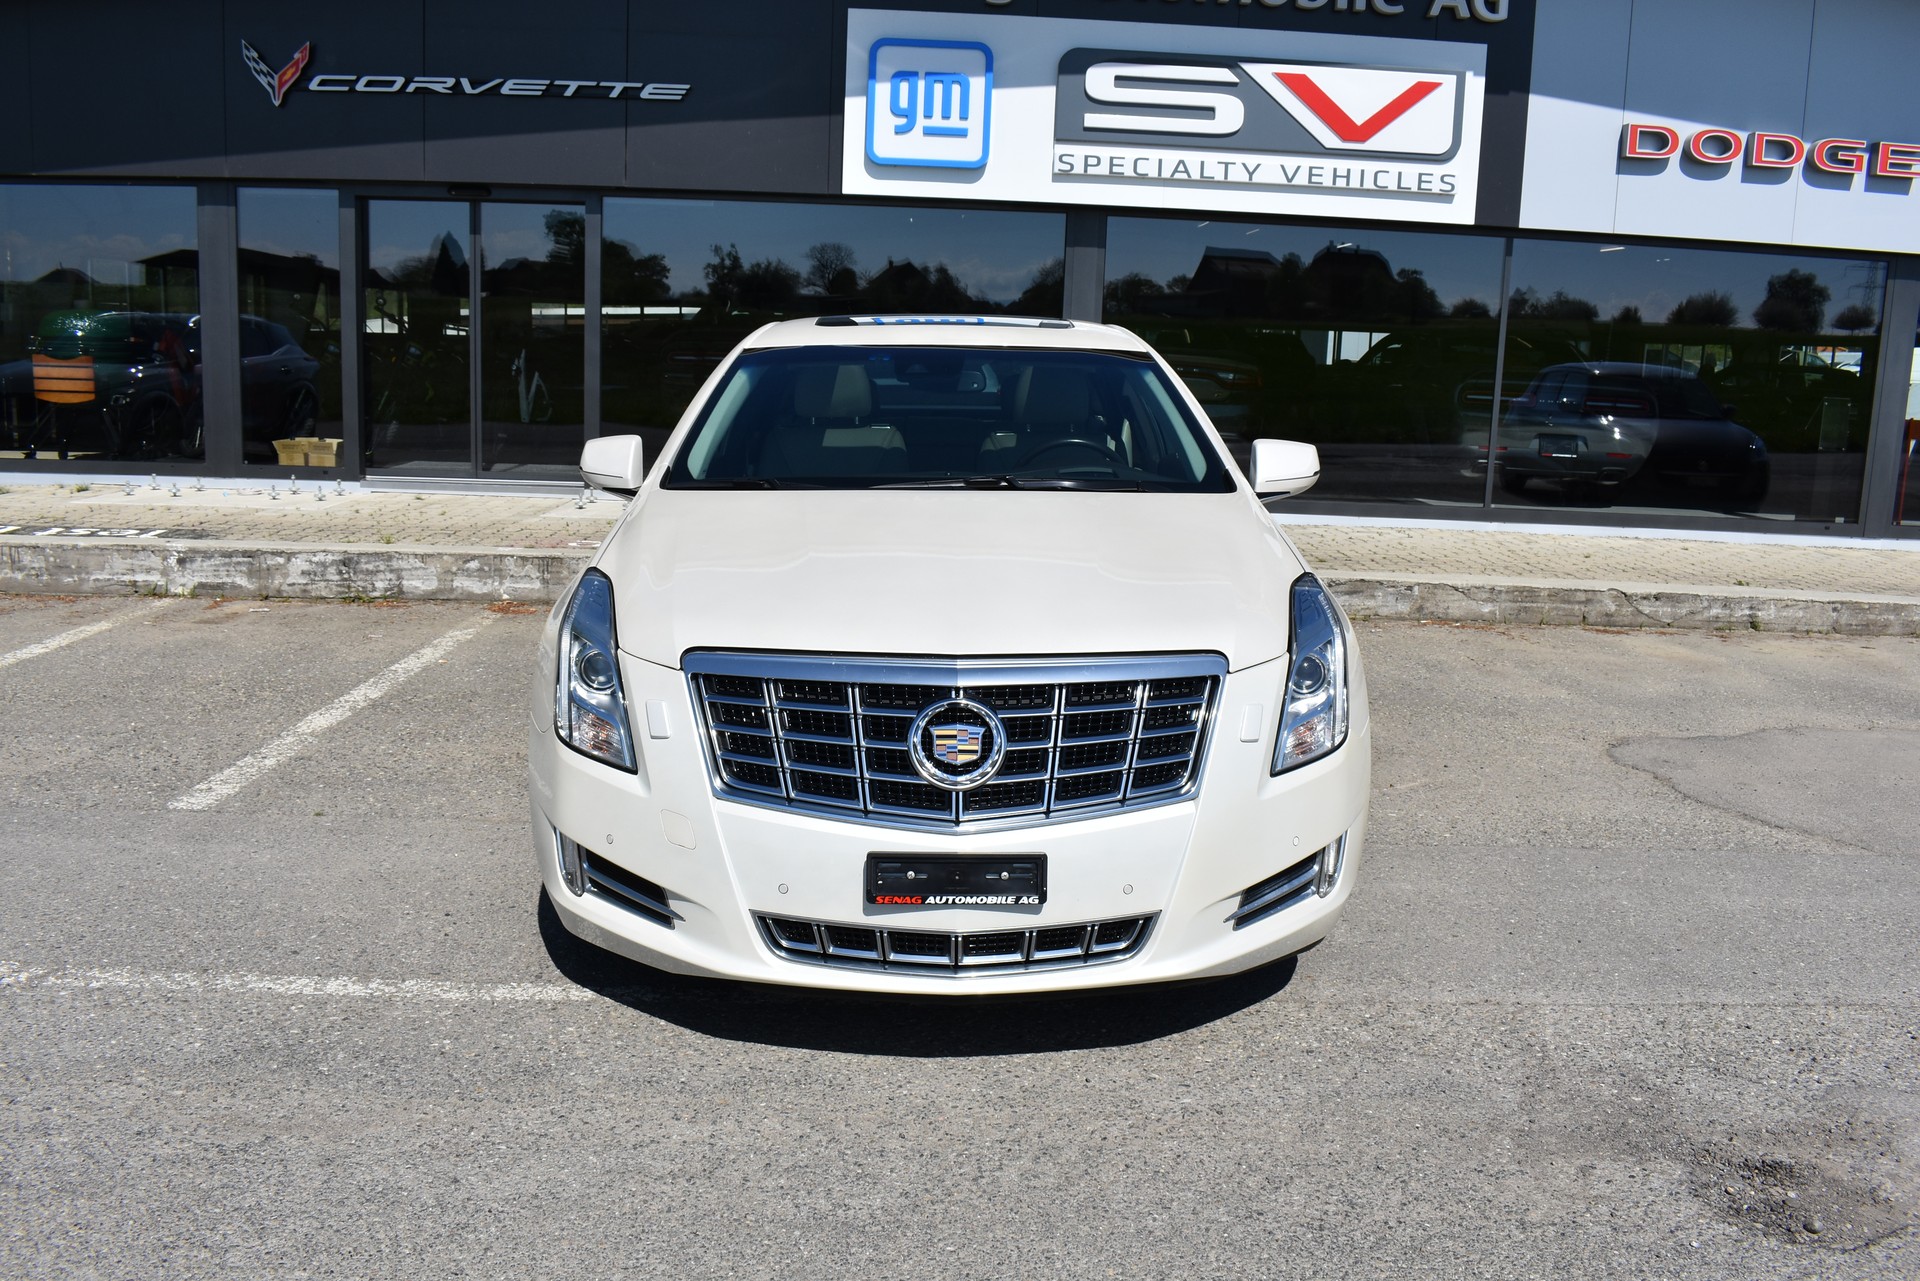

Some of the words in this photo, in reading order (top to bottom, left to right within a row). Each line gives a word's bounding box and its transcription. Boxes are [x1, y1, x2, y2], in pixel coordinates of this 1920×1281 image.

[308, 74, 691, 100] CORVETTE
[890, 70, 970, 136] gm
[1083, 61, 1443, 143] SV
[1056, 153, 1262, 181] SPECIALTY
[1280, 164, 1456, 194] VEHICLES
[1624, 123, 1920, 178] DODGE
[875, 895, 922, 904] SENAG
[925, 895, 1015, 904] AUTOMOBILE
[1018, 896, 1039, 904] AG
